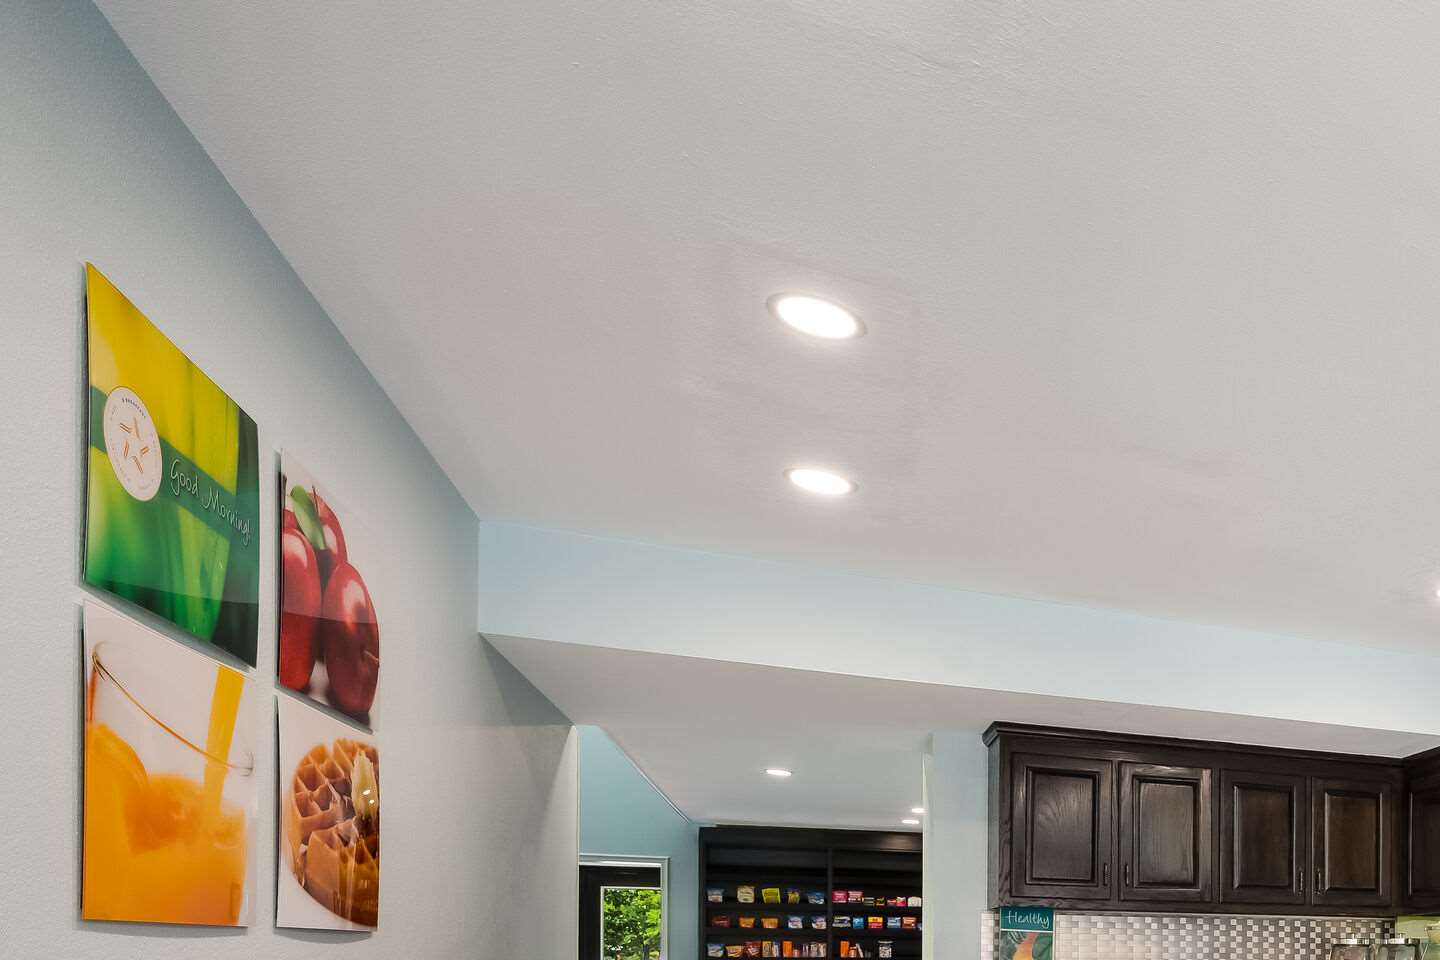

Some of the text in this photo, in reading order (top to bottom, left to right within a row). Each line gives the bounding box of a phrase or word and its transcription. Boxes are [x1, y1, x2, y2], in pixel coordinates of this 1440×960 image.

[170, 458, 251, 546] Good Morning!
[1004, 910, 1050, 929] Healthy
